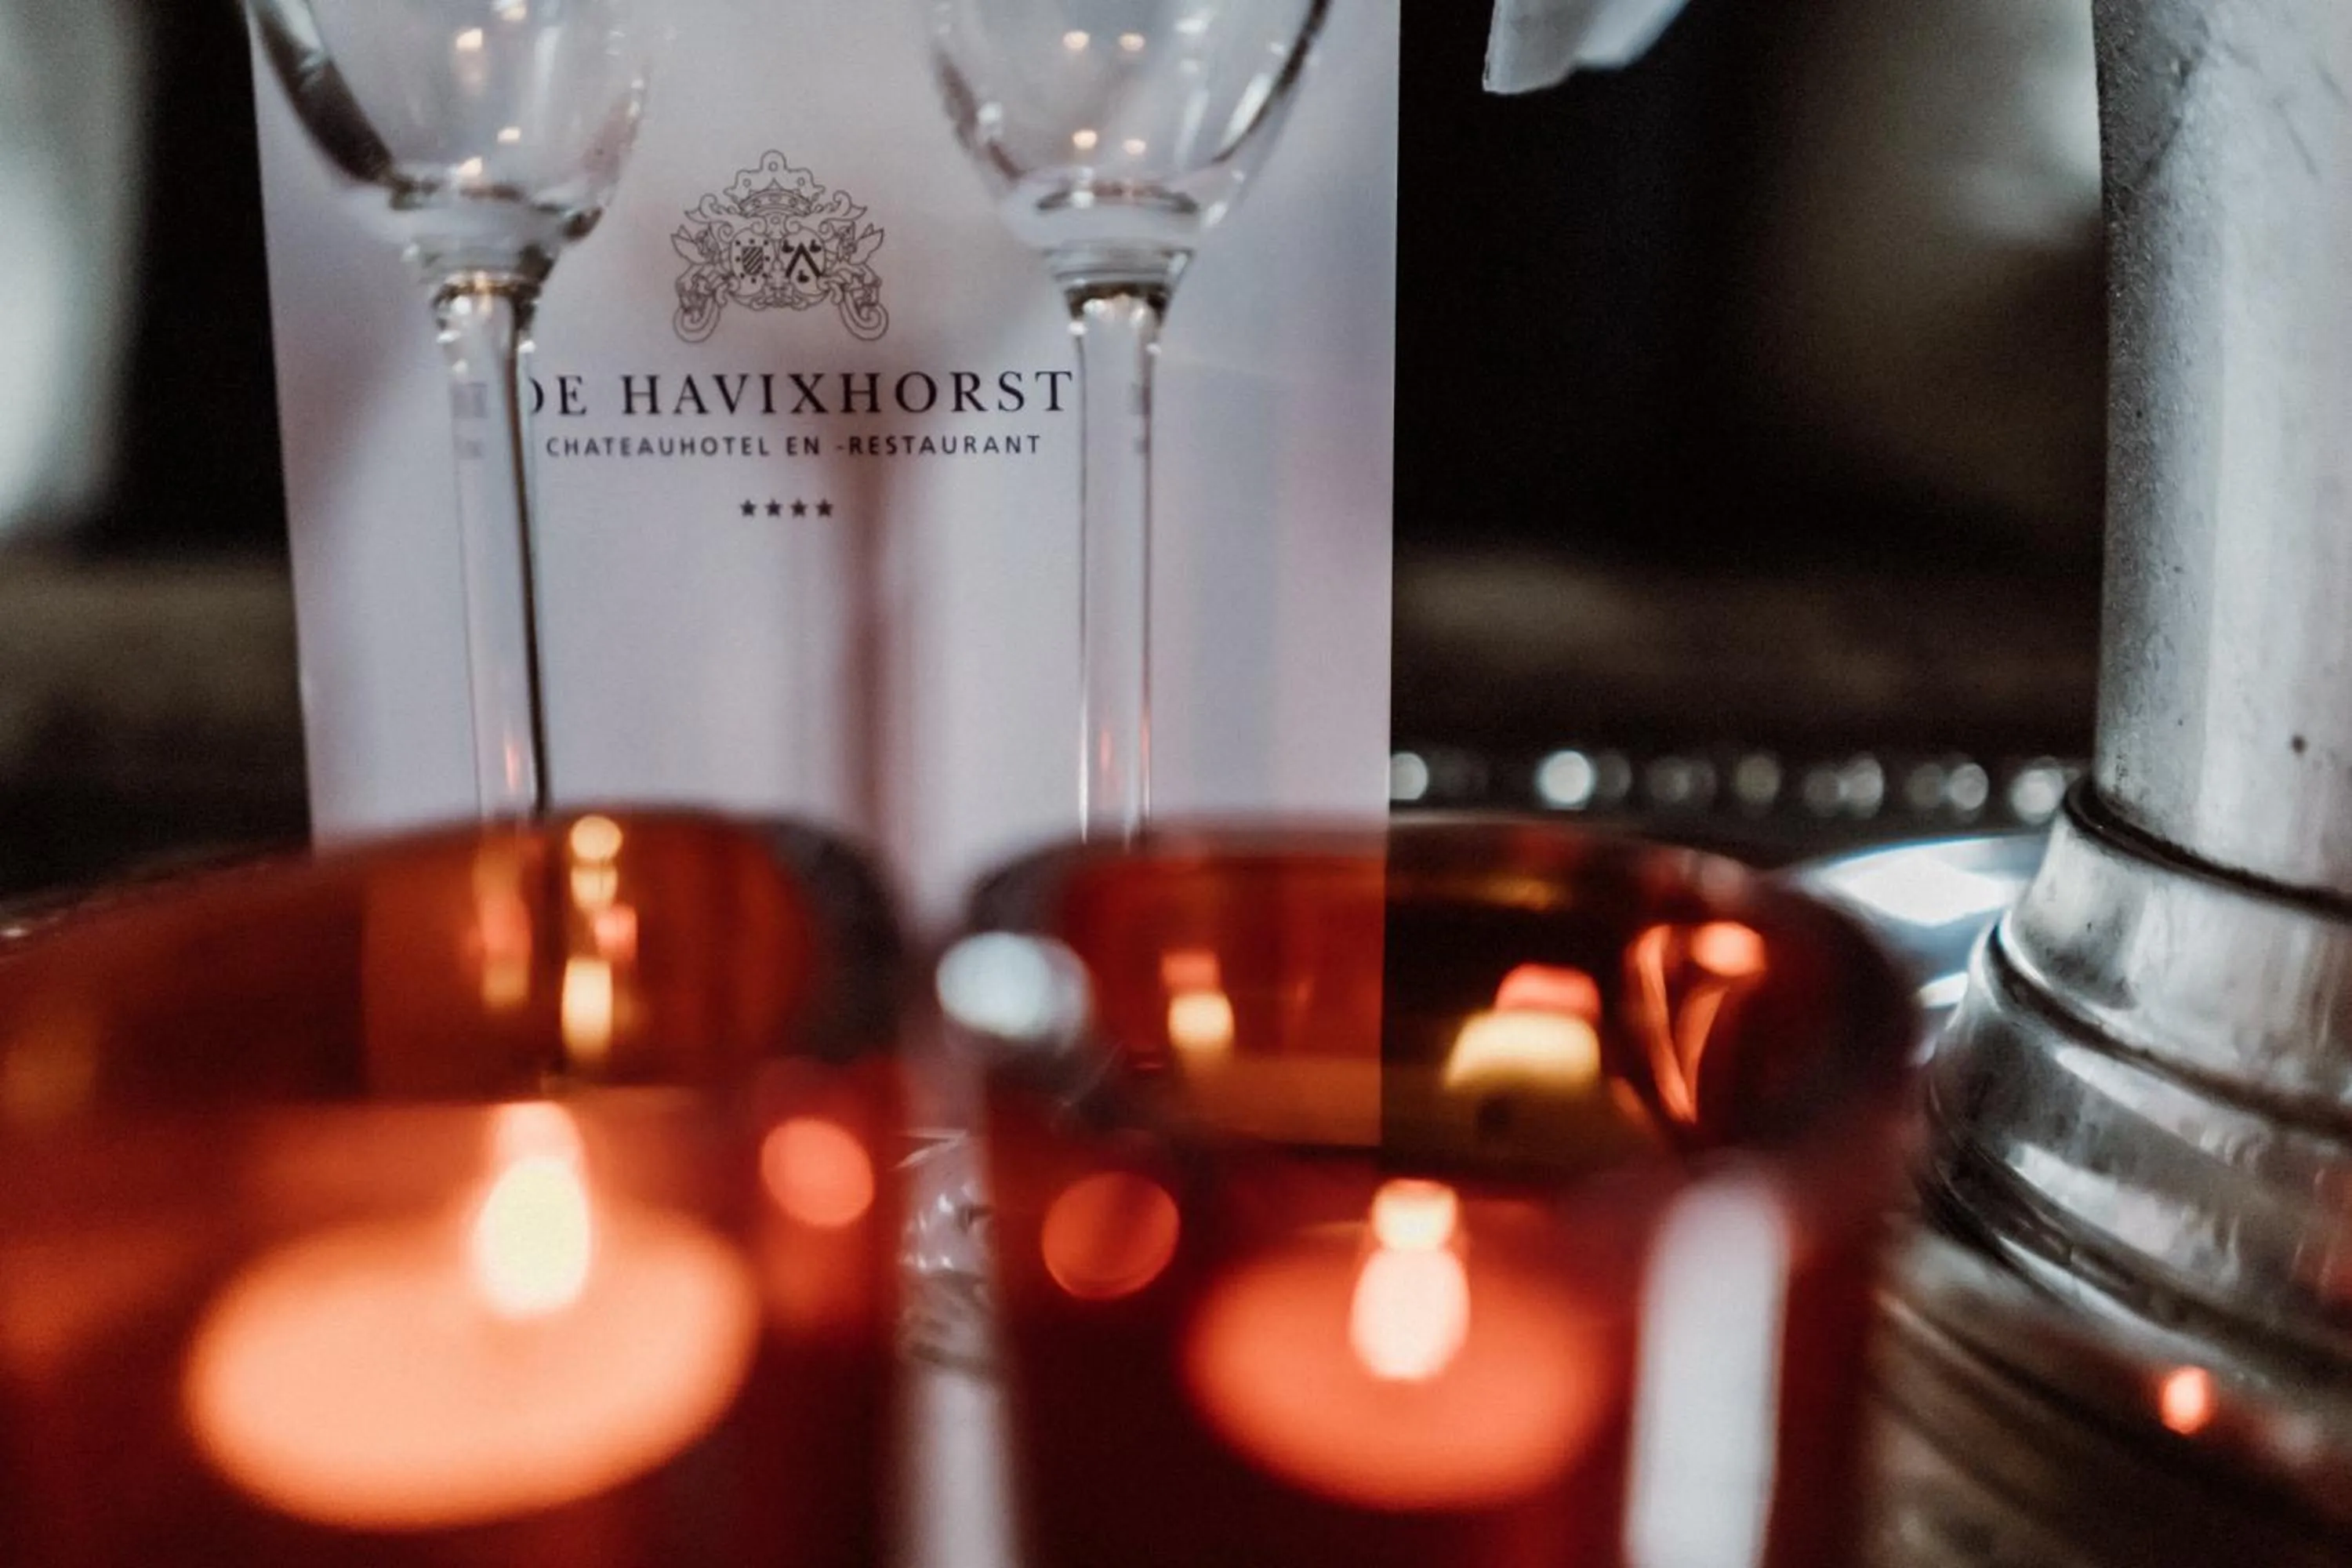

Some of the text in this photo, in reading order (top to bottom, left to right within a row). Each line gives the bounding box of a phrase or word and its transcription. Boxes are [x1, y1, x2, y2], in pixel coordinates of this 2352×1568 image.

[619, 371, 1073, 416] HAVIXHORST
[546, 434, 1041, 456] CHATEAUHOTEL EN -RESTAURANT
